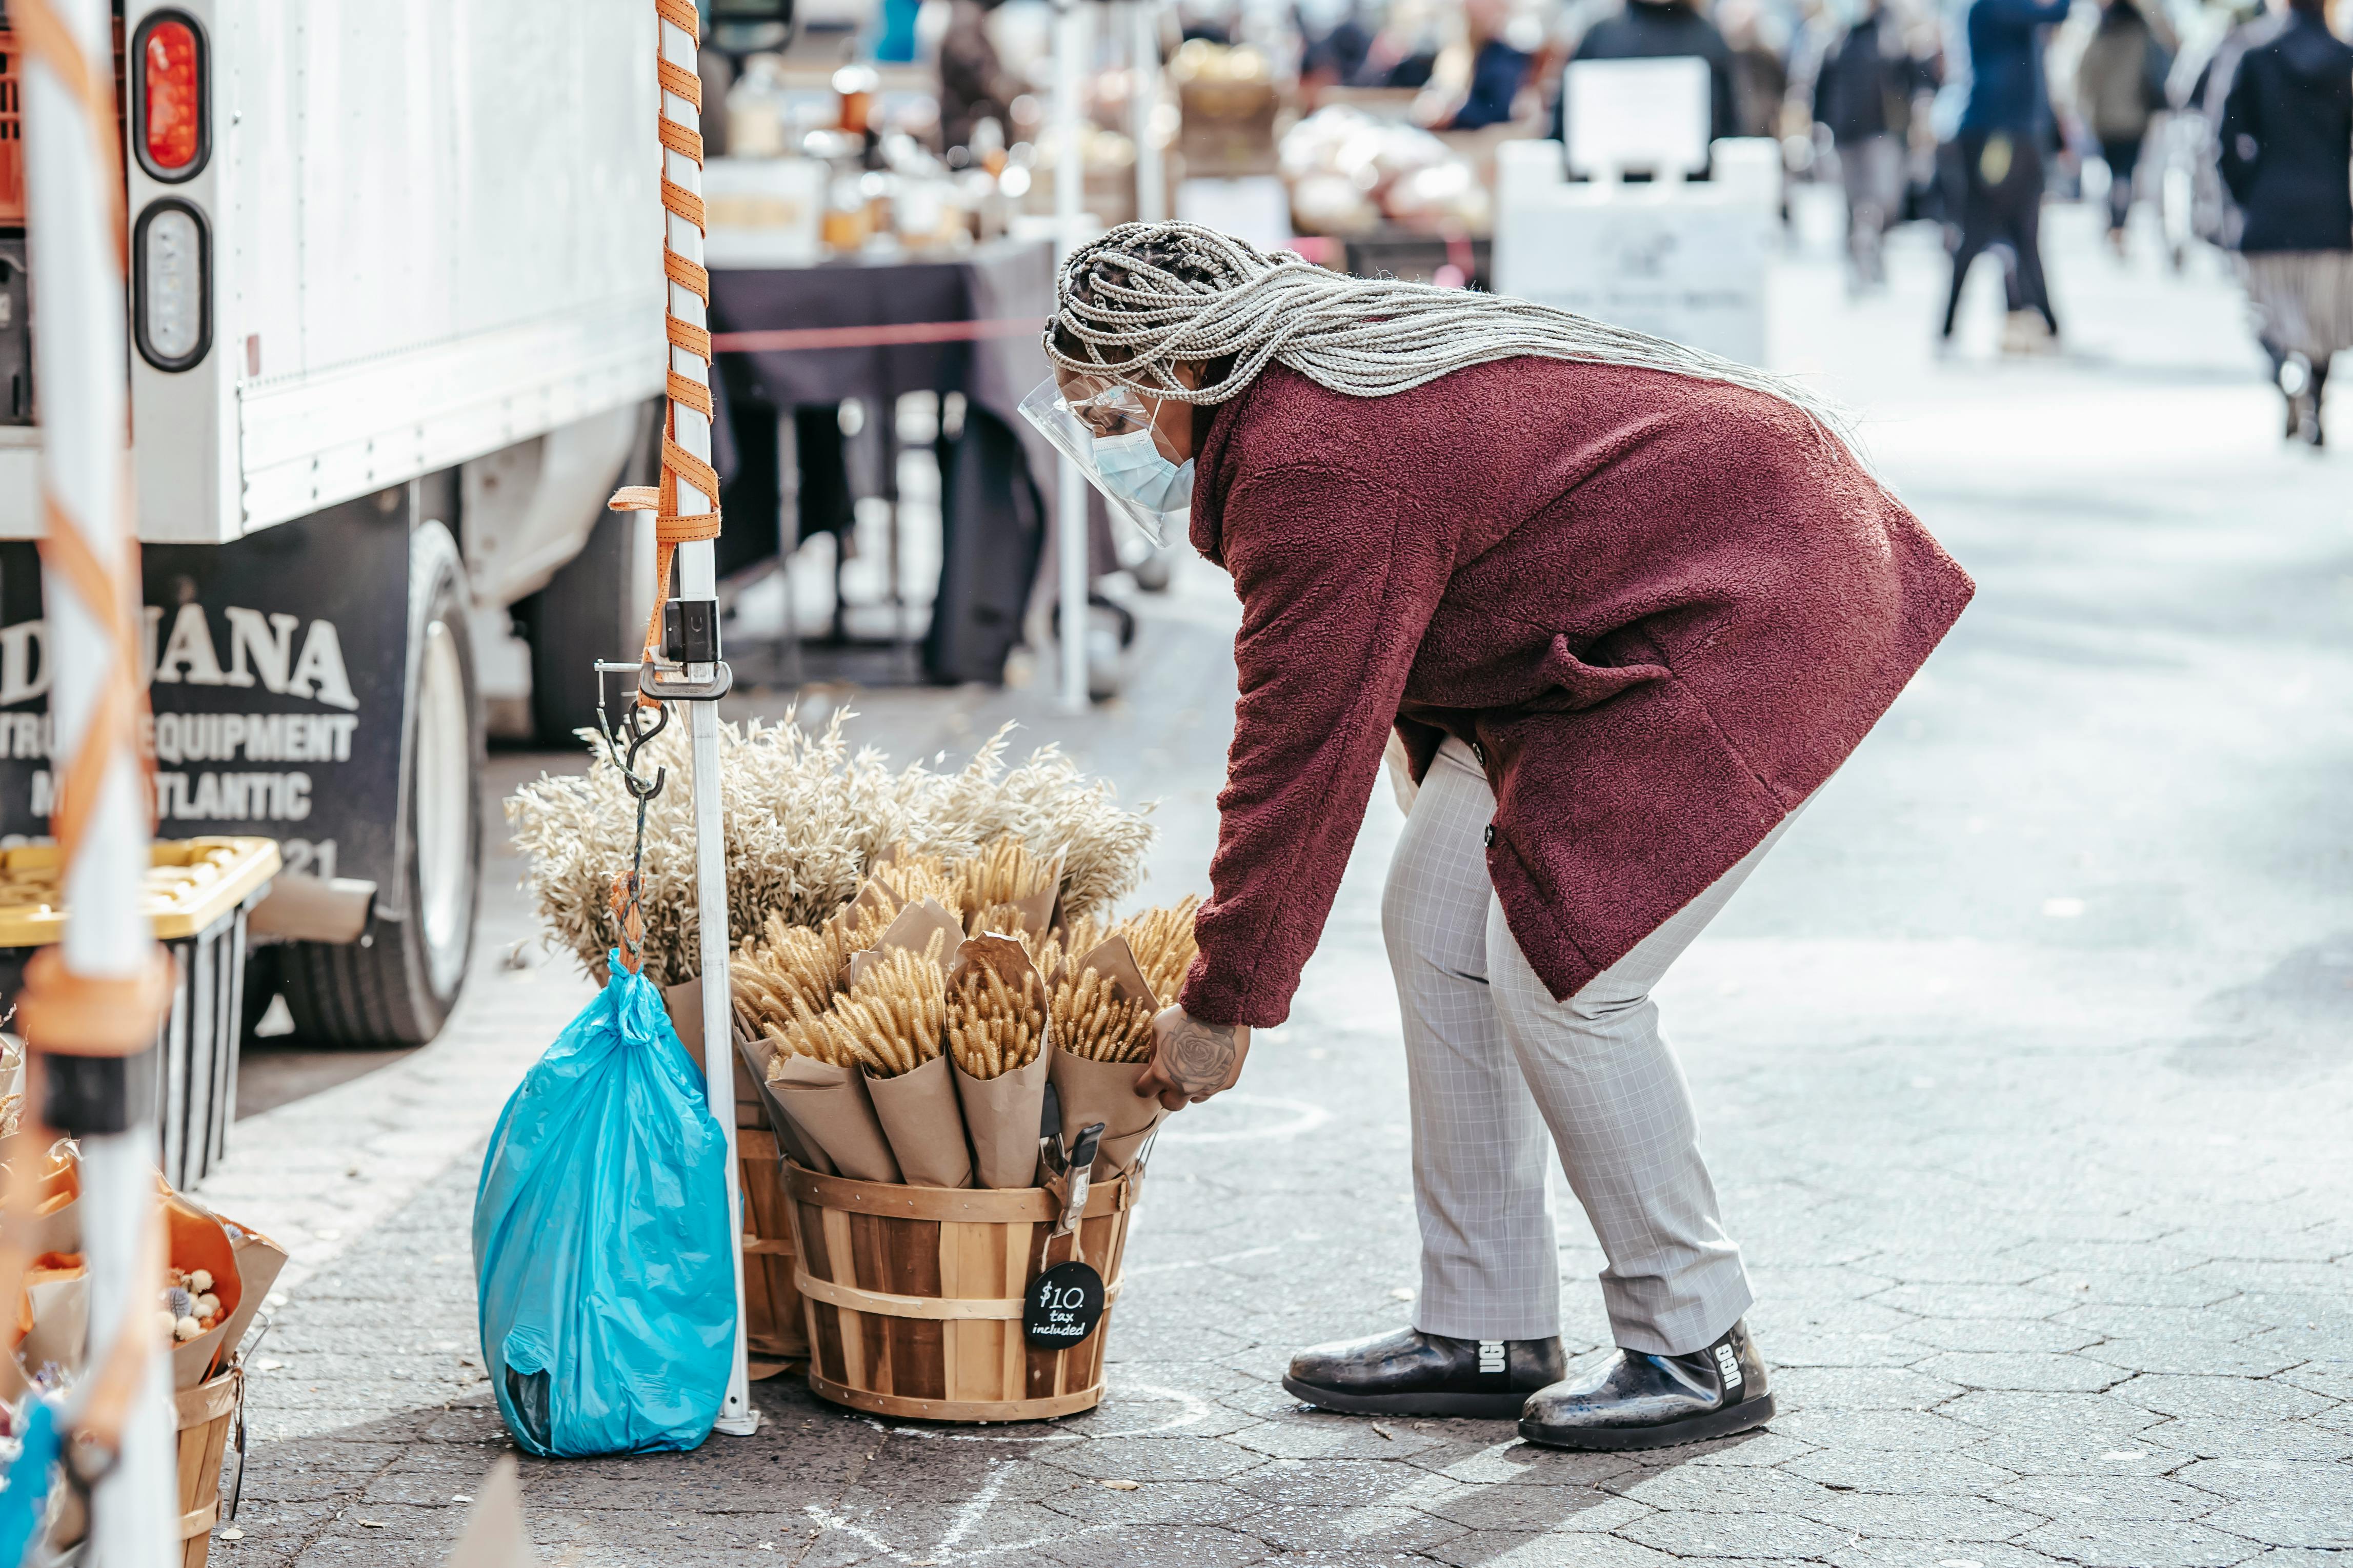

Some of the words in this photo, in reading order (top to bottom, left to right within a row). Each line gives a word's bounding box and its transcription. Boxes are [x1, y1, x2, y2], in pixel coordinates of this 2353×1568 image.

[1050, 1310, 1074, 1323] tax
[1033, 1322, 1085, 1335] included
[1715, 1343, 1742, 1390] UGG
